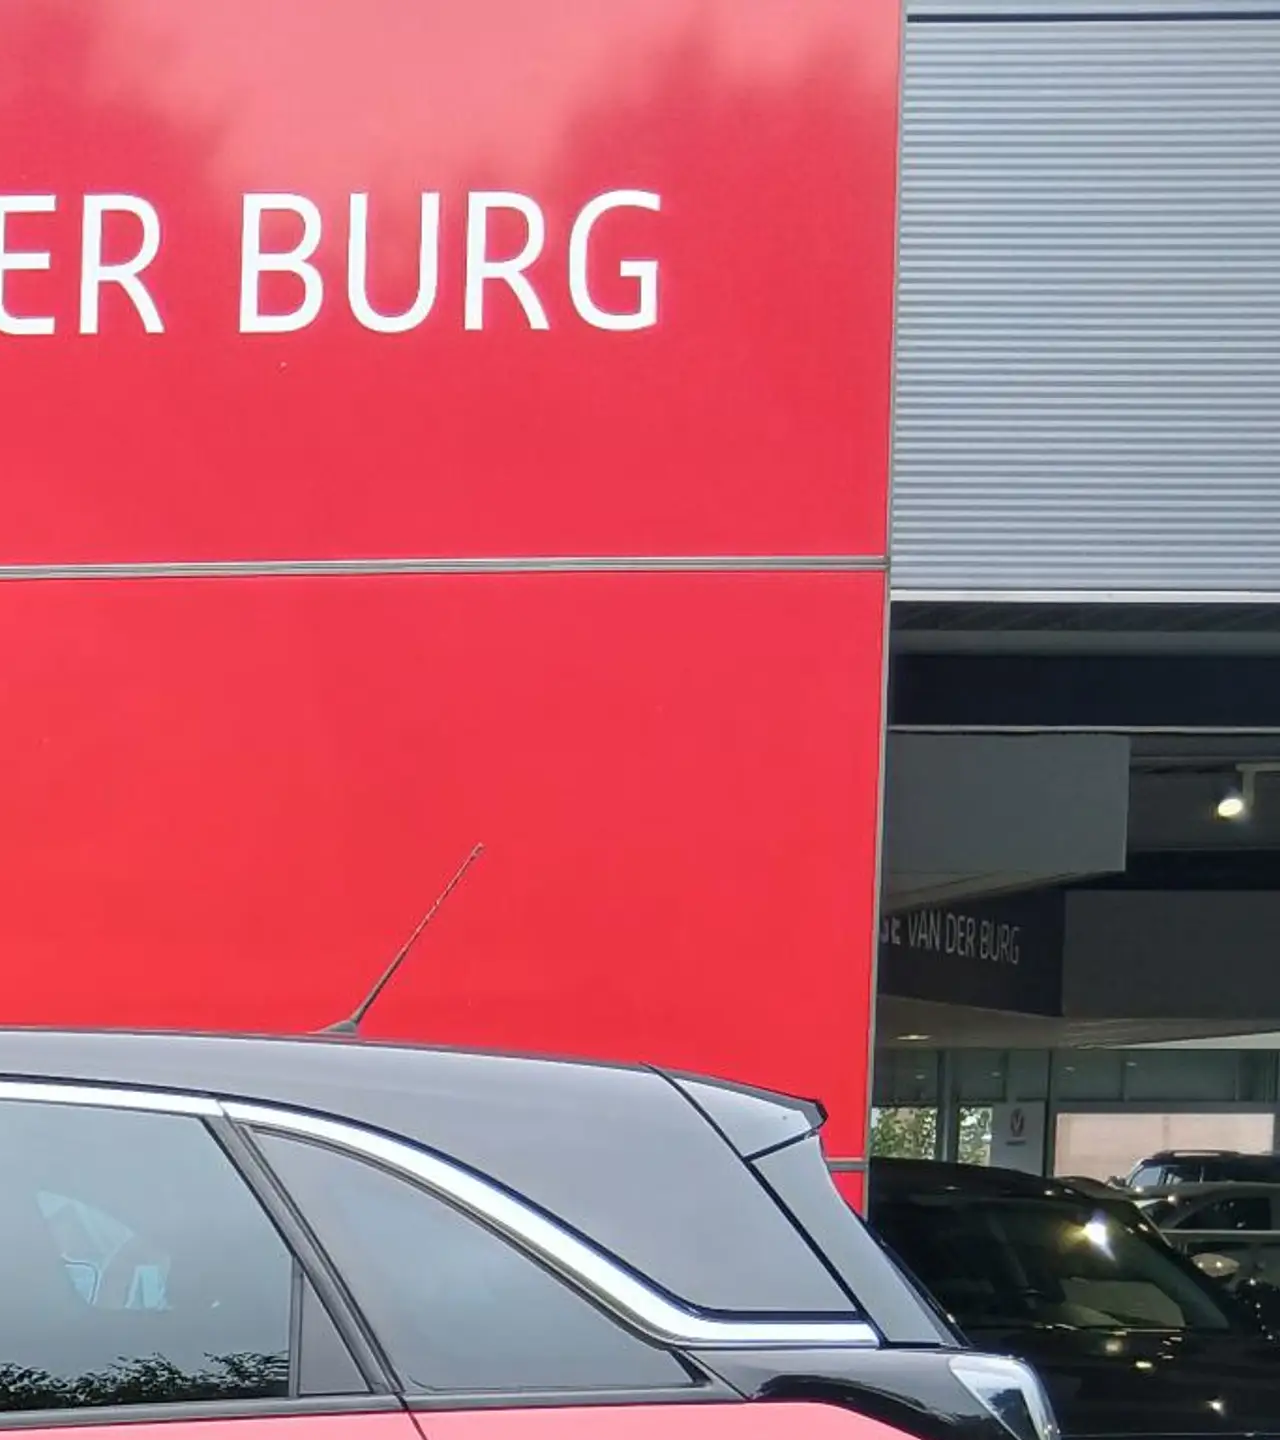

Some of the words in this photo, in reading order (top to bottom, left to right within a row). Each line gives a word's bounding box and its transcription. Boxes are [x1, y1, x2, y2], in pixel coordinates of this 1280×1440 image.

[238, 189, 662, 335] BURG
[908, 910, 941, 951] VAN
[945, 913, 975, 957] DER
[979, 919, 1020, 965] BURG
